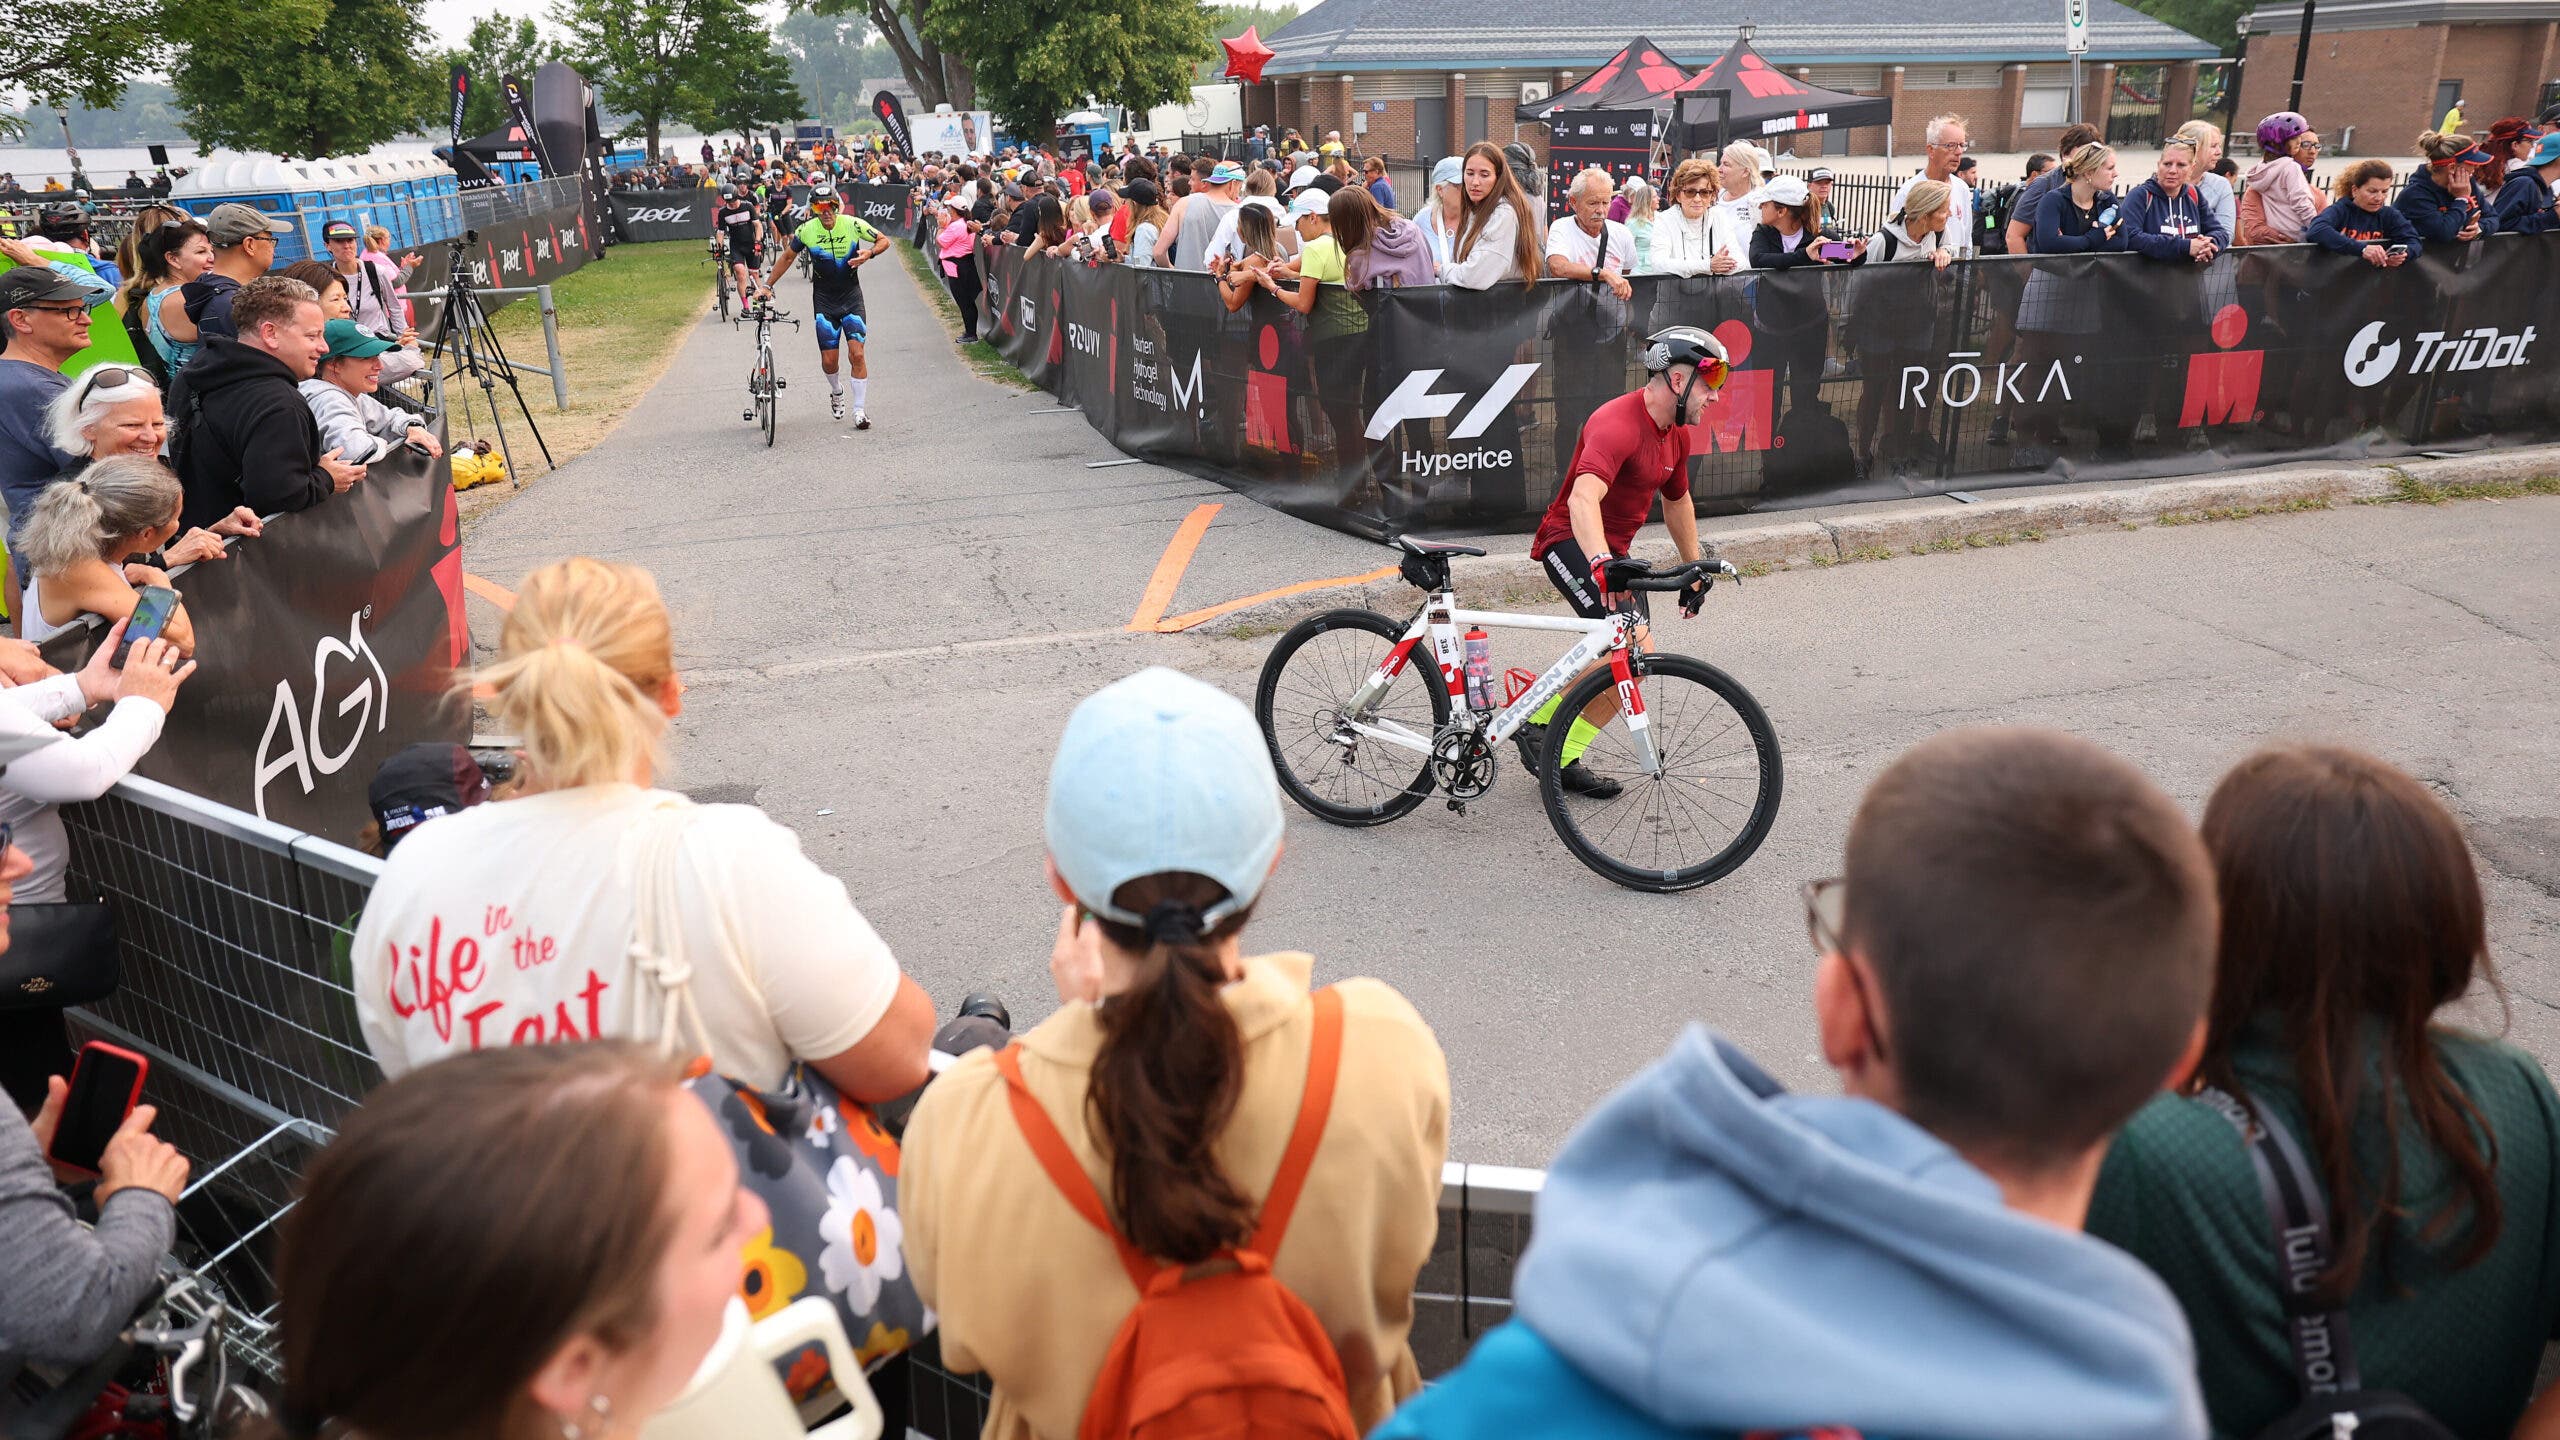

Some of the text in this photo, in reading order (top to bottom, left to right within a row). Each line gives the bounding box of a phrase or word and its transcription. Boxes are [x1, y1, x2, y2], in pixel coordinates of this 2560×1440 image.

[1373, 102, 1385, 111] 100
[887, 113, 912, 157] BOTTLE FILL
[1630, 123, 1647, 133] QATAR
[1762, 109, 1830, 135] IRONMAN
[496, 146, 536, 160] IRONM
[457, 178, 487, 188] UVY
[1068, 322, 1101, 358] ROUVY
[2408, 325, 2538, 374] TriDot
[1133, 357, 1158, 384] Hydrogel
[1132, 380, 1167, 412] Technology
[1401, 446, 1513, 476] Hyperice
[1547, 550, 1595, 610] IRONMAN
[1440, 638, 1450, 655] 338
[1496, 643, 1588, 733] ARGON 18
[390, 905, 558, 1043] Life in the
